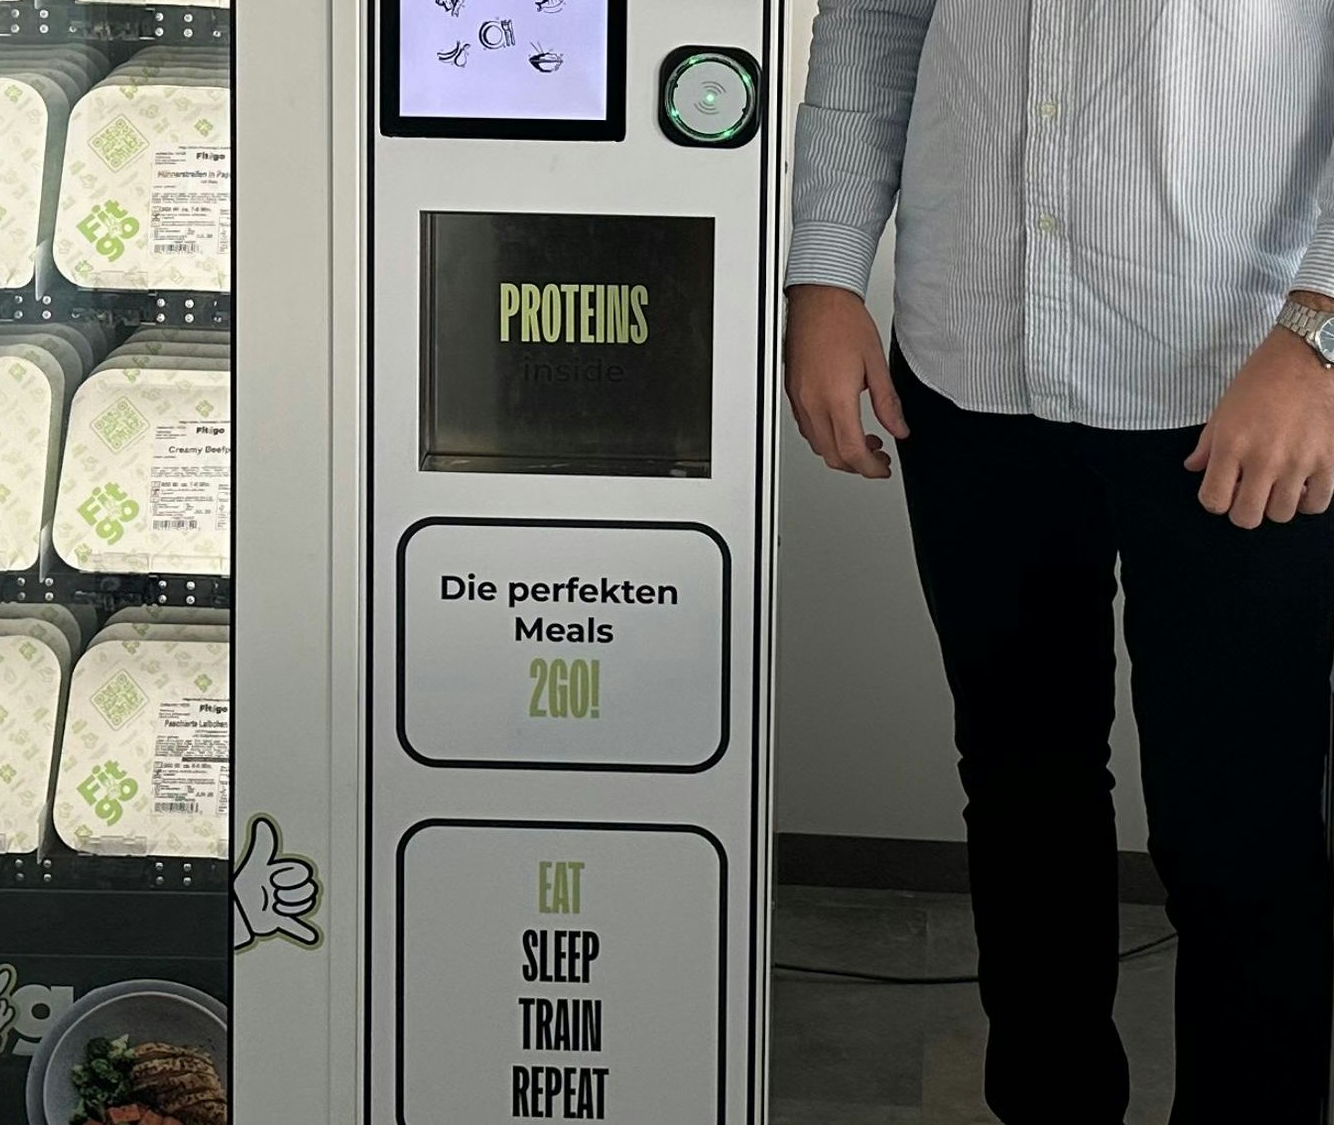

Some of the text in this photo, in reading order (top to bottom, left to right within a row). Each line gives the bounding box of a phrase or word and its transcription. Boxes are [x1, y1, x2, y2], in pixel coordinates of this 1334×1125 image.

[499, 282, 649, 344] PROTEINS
[523, 356, 625, 384] inside
[168, 445, 204, 455] Creamy
[440, 572, 679, 608] Die perfekten
[514, 616, 614, 644] Meals
[529, 658, 600, 719] 2GO!
[538, 861, 585, 915] EAT
[522, 929, 600, 984] SLEEP
[518, 997, 602, 1052] TRAIN
[512, 1065, 610, 1120] REPEAT
